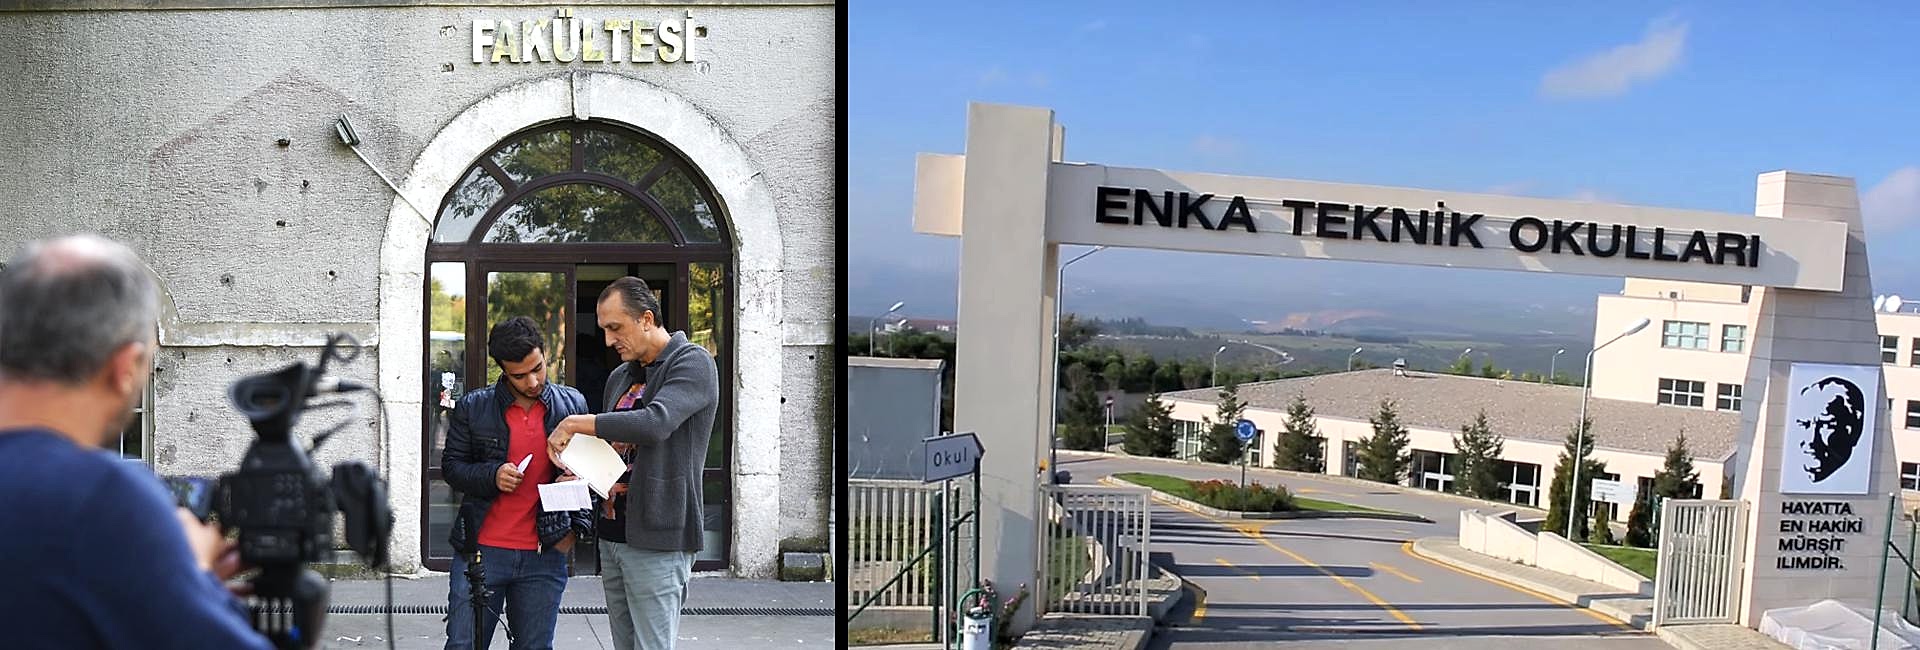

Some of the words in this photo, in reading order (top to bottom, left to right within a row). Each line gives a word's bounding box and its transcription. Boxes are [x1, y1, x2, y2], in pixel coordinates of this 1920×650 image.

[472, 8, 695, 63] FAKÜLTESİ
[1095, 186, 1257, 233] ENKA
[1283, 199, 1485, 248] TEKNİK
[1509, 215, 1760, 268] OKULLARI
[933, 447, 967, 467] Okul
[1781, 502, 1852, 515] HAYATTA
[1780, 520, 1803, 532] EN
[1808, 517, 1862, 533] HAKİKİ
[1778, 535, 1845, 554] MÜRŞİT
